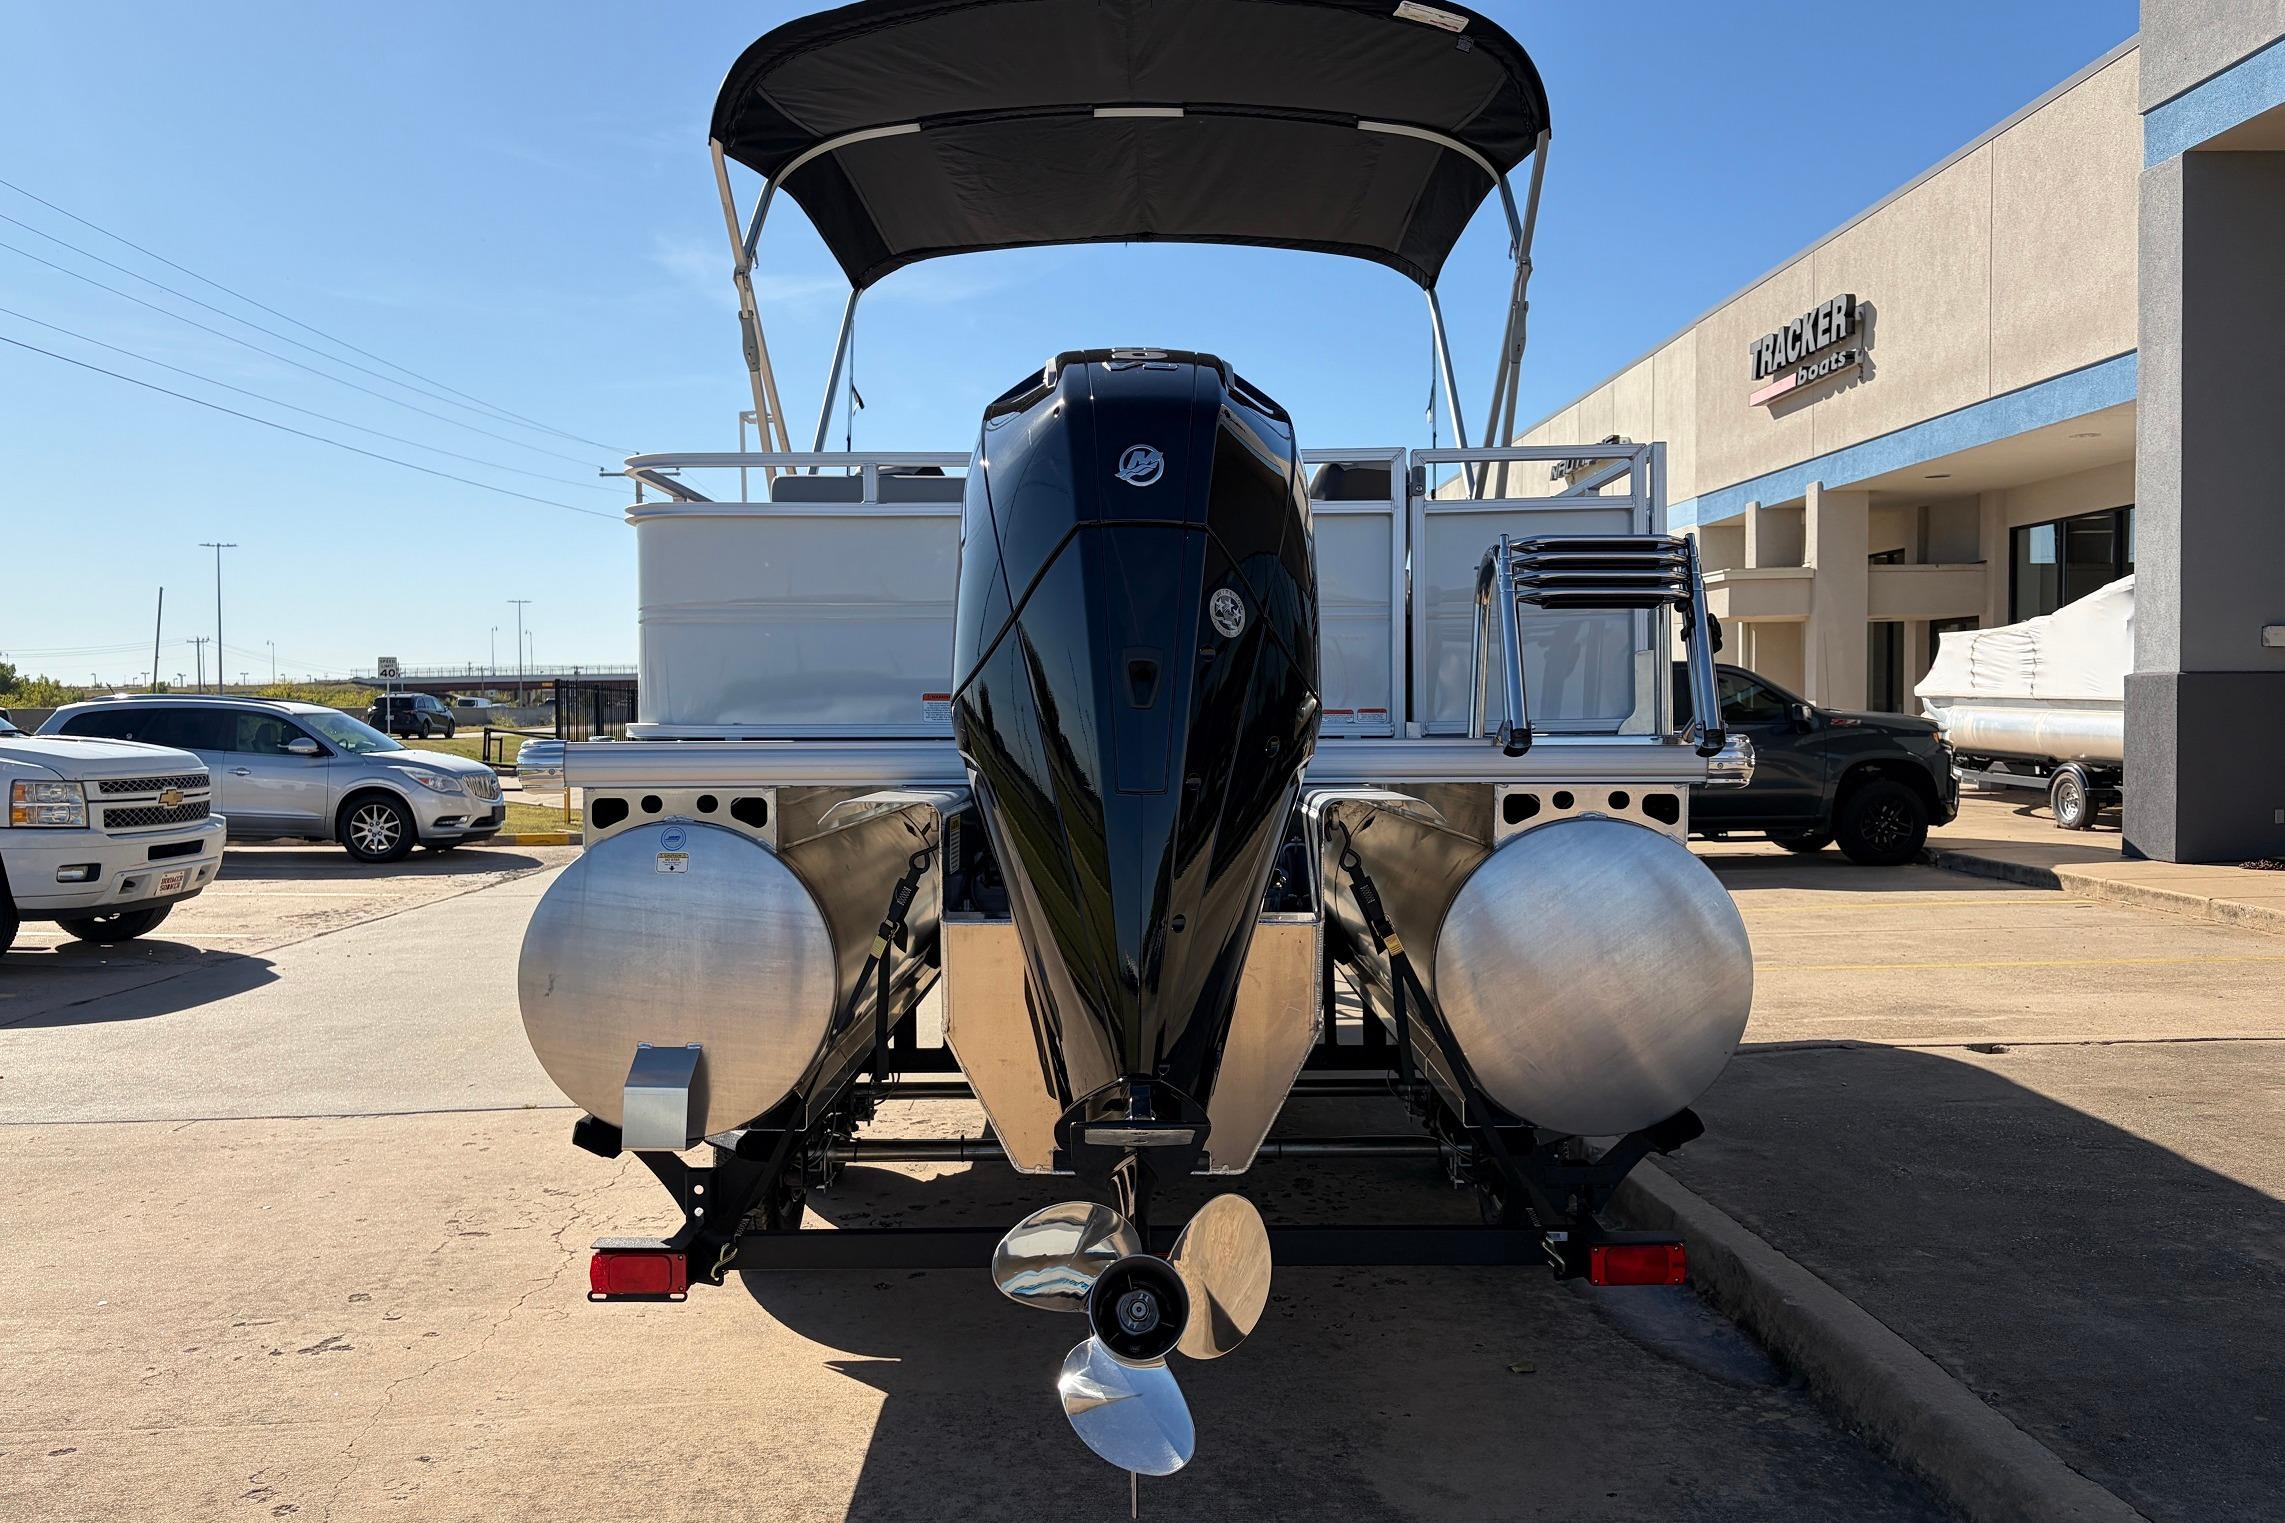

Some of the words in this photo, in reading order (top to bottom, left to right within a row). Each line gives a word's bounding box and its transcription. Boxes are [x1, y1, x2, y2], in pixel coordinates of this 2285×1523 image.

[1750, 294, 1848, 380] TRACKER
[1797, 351, 1847, 386] boats
[380, 669, 396, 678] 40
